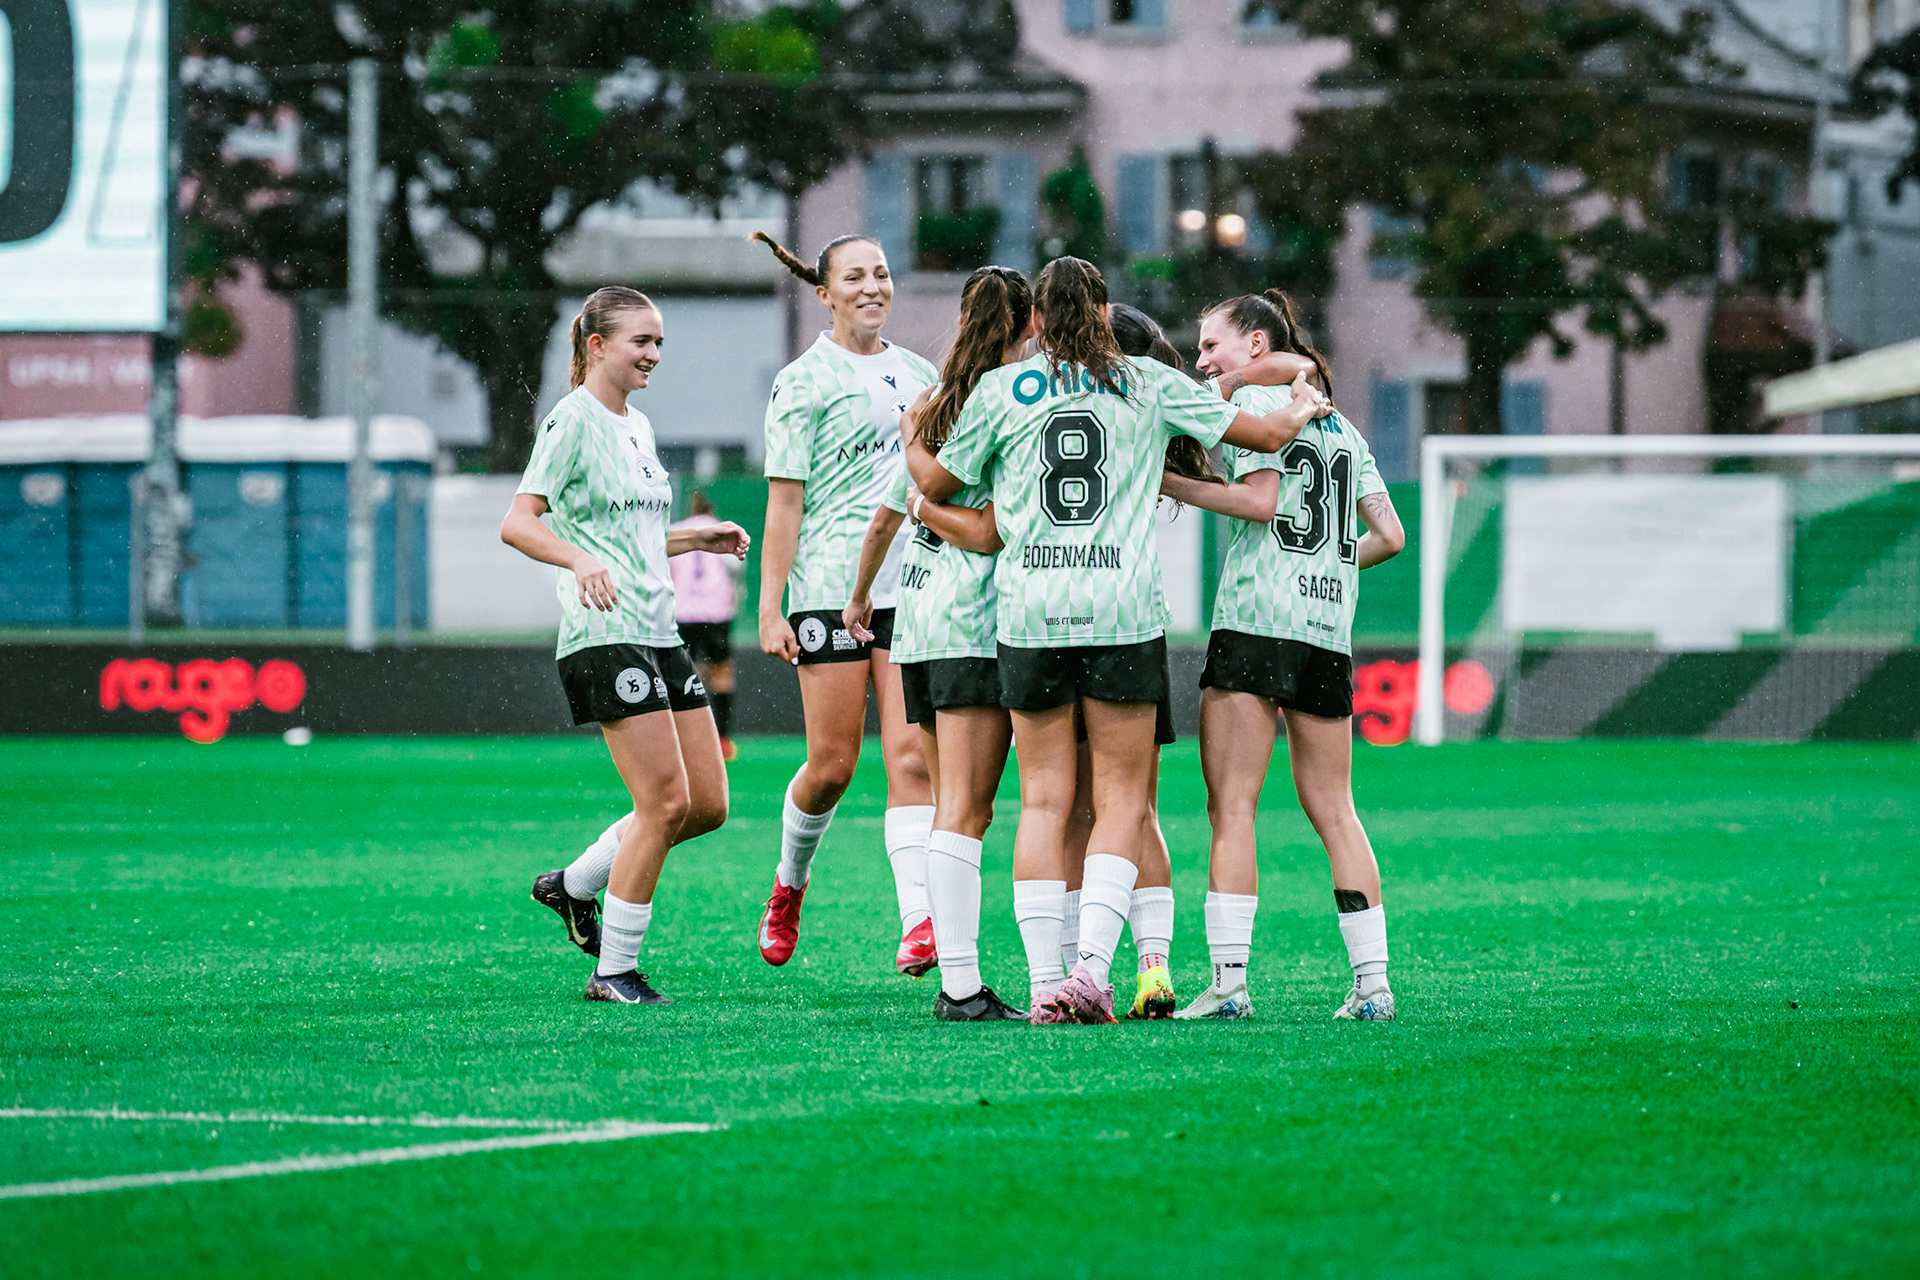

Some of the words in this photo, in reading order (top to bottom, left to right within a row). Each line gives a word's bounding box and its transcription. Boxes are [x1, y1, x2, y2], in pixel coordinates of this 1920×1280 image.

[1040, 410, 1107, 526] 8
[1271, 439, 1357, 565] 31
[1022, 544, 1121, 569] BODENMANN
[1298, 574, 1342, 604] SAGER
